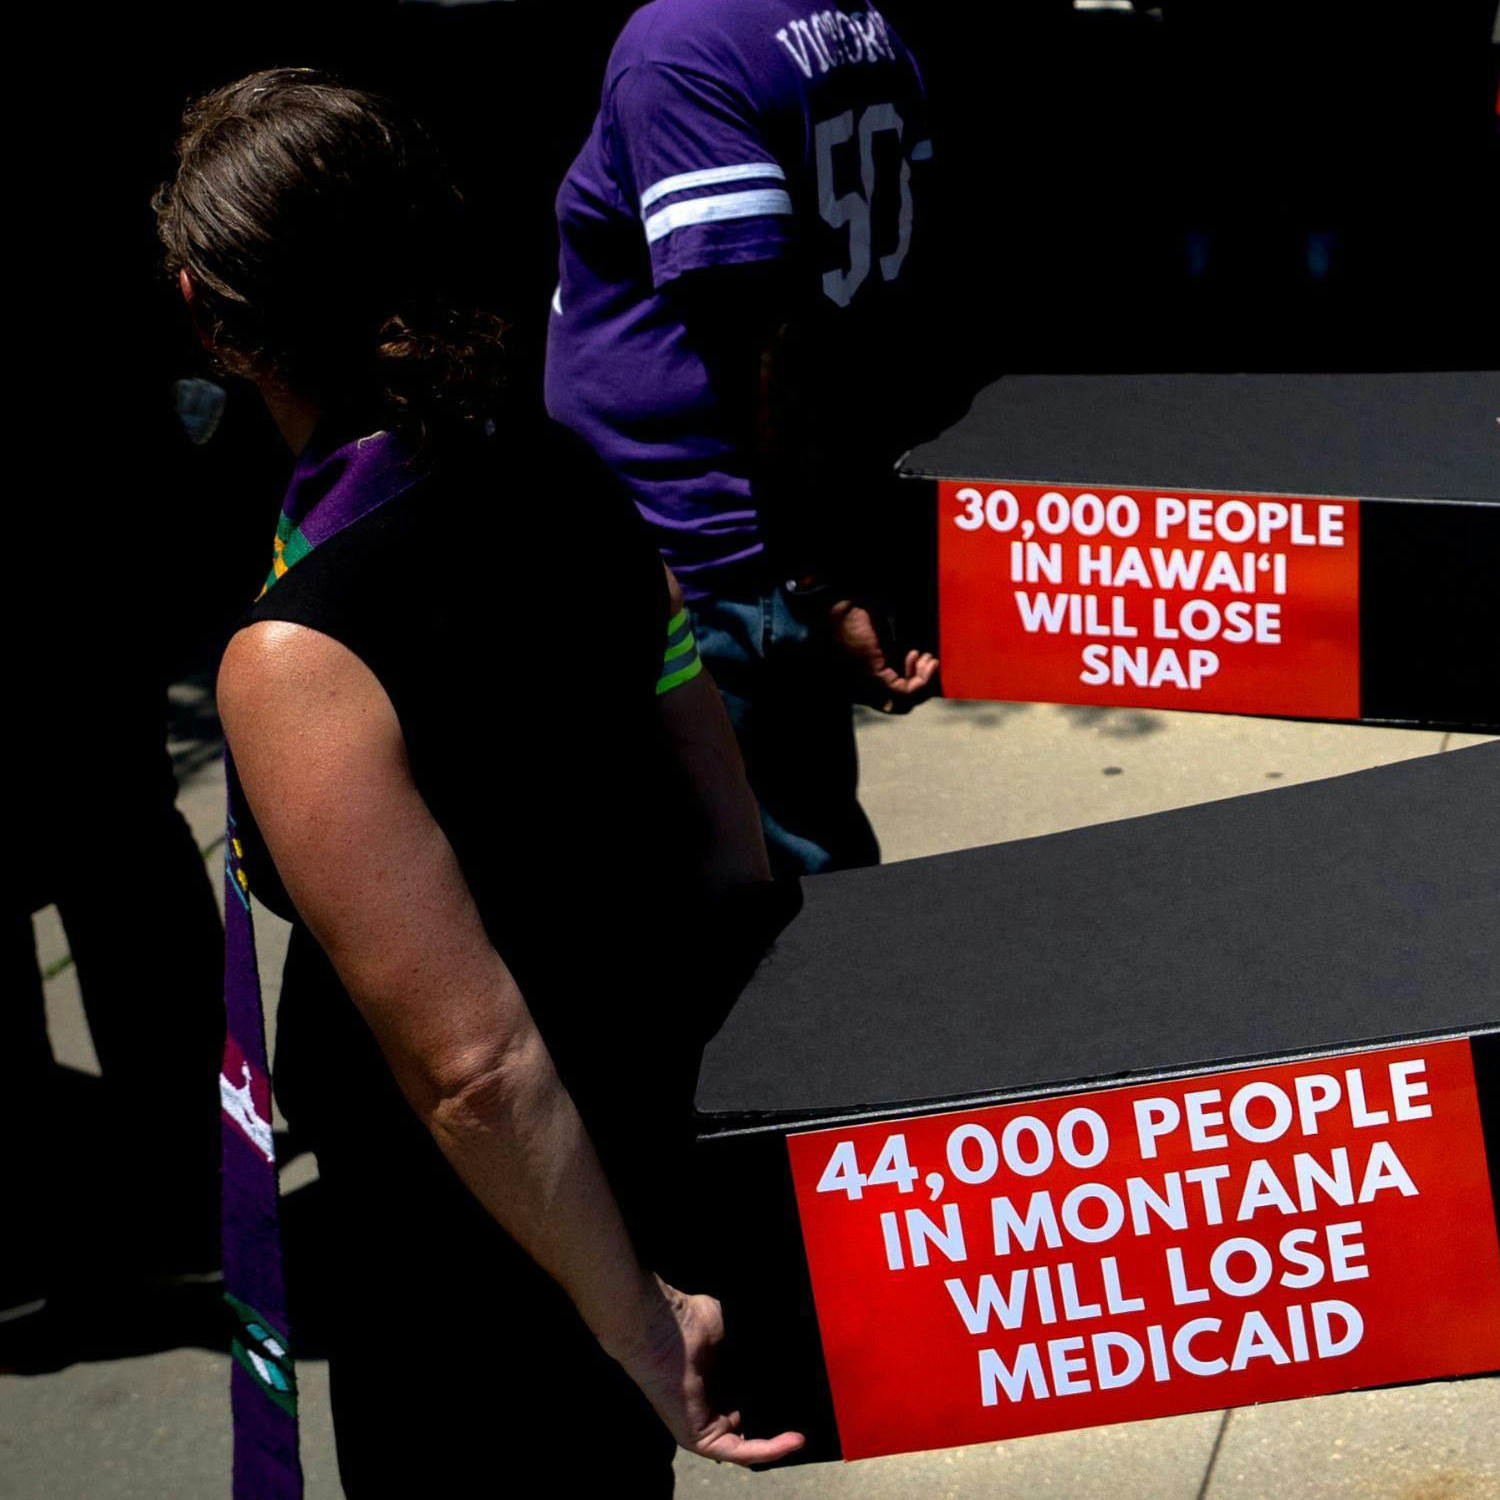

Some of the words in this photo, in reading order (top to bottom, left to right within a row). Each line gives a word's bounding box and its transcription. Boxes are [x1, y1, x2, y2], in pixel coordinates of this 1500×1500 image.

[815, 102, 914, 308] 50
[954, 488, 1140, 540] 30,000
[1155, 497, 1344, 547] PEOPLE
[1010, 541, 1063, 584] IN
[1014, 591, 1138, 637] WILL
[1153, 597, 1281, 644] LOSE
[1079, 643, 1220, 690] SNAP
[816, 1107, 1110, 1202] 44,000
[1133, 1058, 1433, 1160] PEOPLE
[879, 1202, 968, 1271] IN
[991, 1140, 1420, 1256] MONTANA
[943, 1256, 1146, 1335] WILL
[1165, 1220, 1370, 1306] LOSE
[978, 1299, 1364, 1407] MEDICAID
